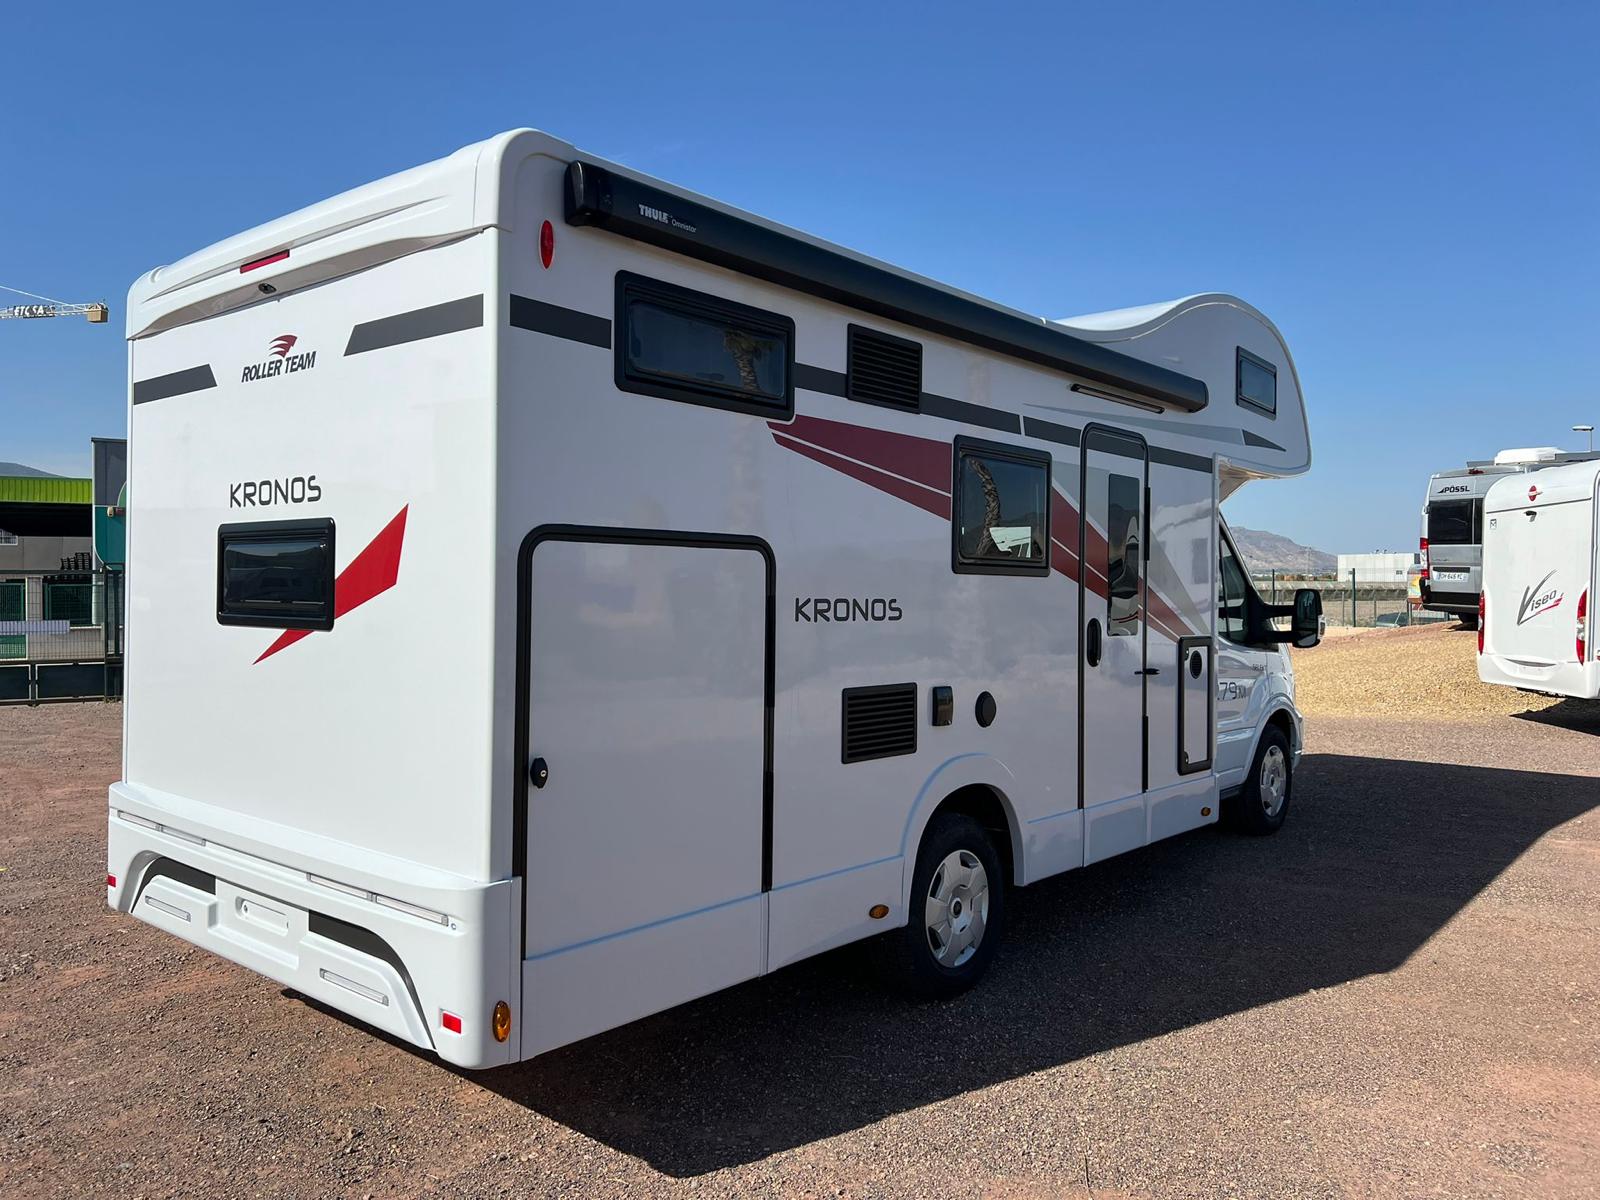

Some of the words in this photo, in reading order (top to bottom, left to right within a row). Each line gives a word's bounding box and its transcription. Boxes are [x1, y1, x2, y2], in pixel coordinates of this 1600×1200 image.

[638, 203, 669, 224] THULE
[671, 218, 697, 234] Omnistor
[241, 357, 283, 383] ROLLER
[284, 350, 317, 375] TEAM
[229, 475, 322, 509] KRONOS
[794, 597, 903, 623] KRONOS
[1517, 569, 1560, 626] Viseo
